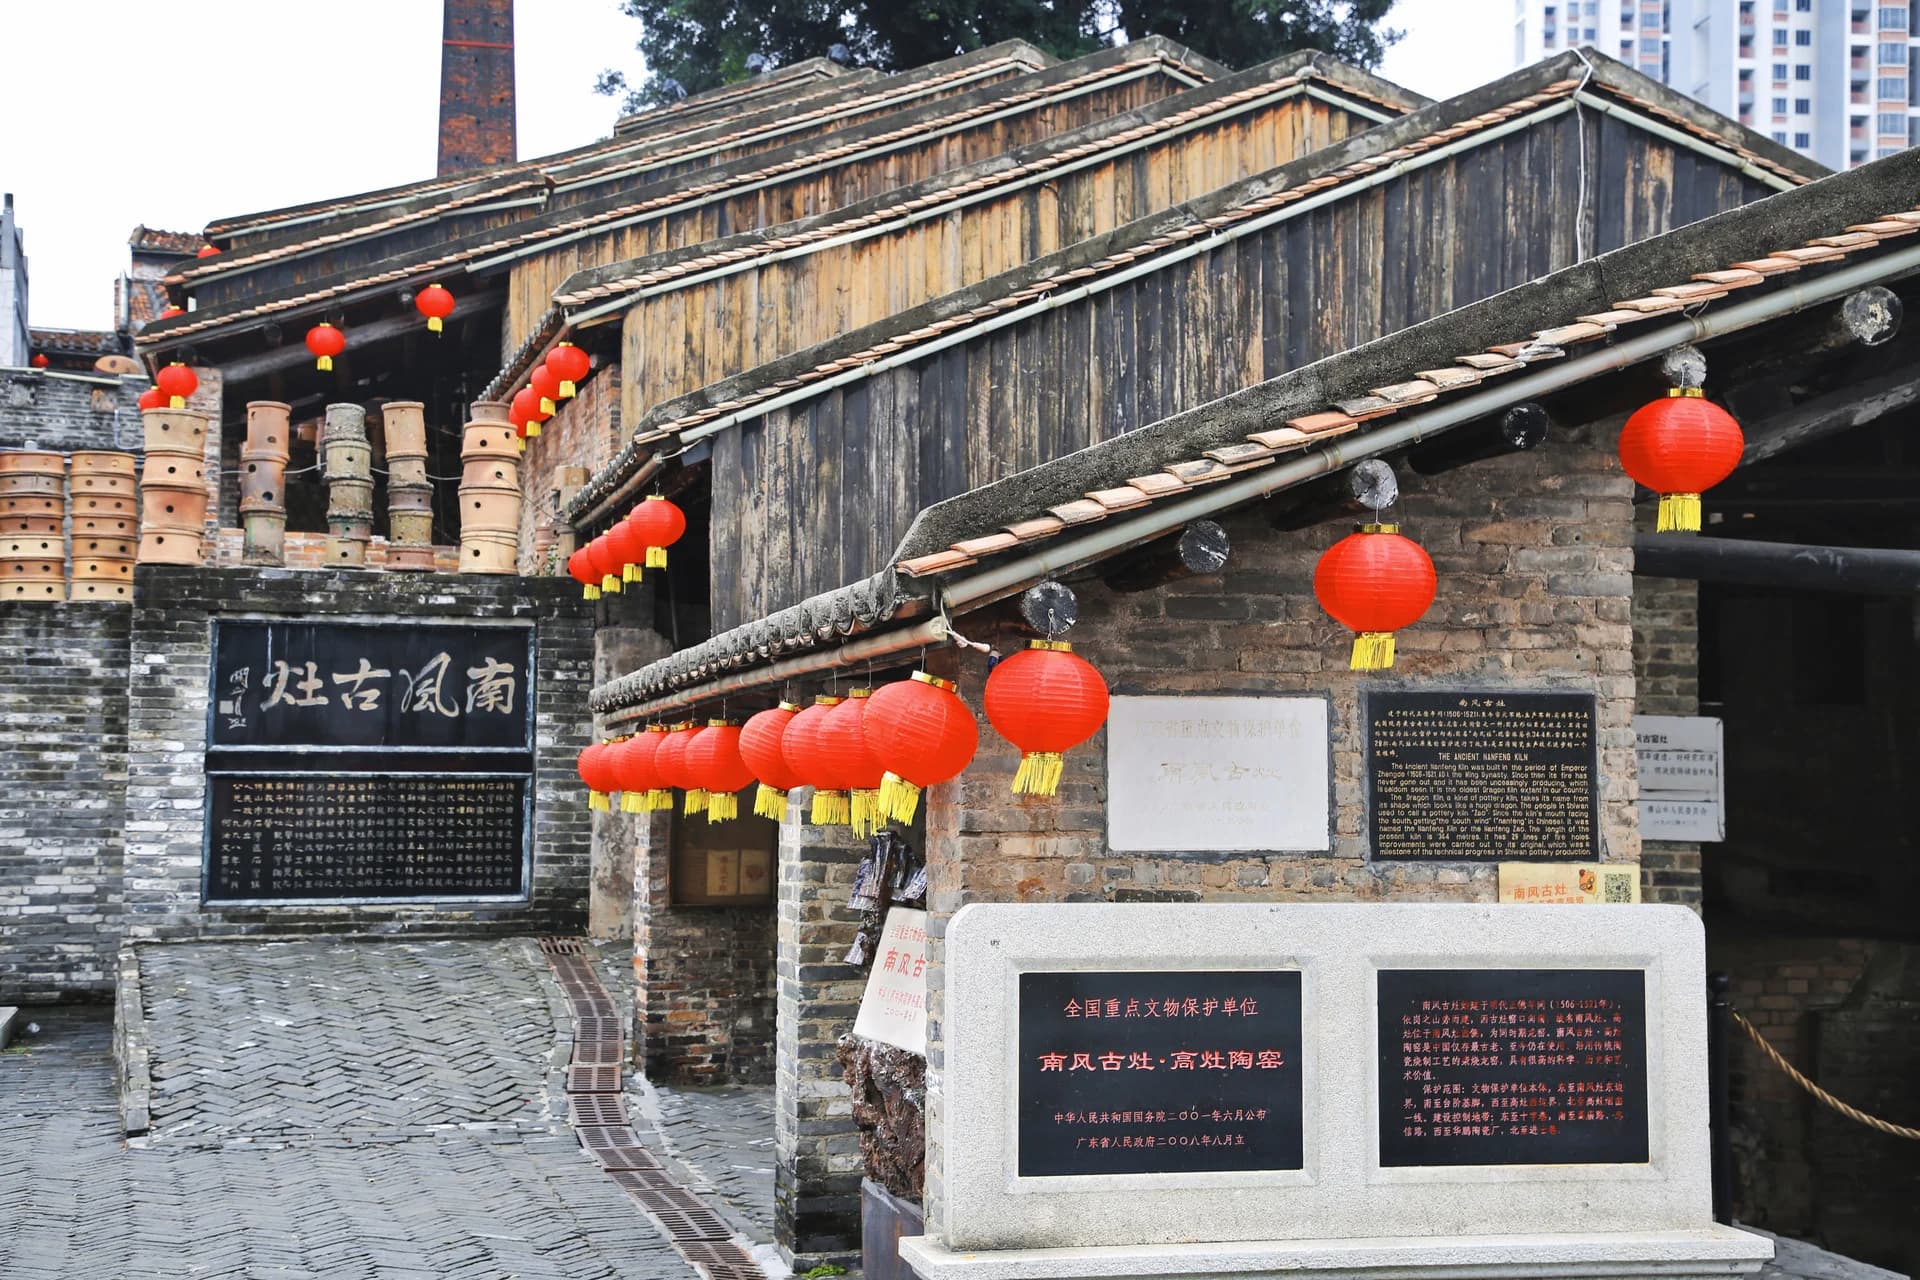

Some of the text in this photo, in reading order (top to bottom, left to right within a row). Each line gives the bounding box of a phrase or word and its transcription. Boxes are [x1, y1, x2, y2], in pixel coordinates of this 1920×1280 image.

[1438, 752, 1450, 760] THE
[1454, 753, 1479, 761] ANCIENT
[1514, 753, 1528, 761] KILN
[1430, 763, 1456, 772] Nanfeng
[1524, 764, 1546, 772] period
[1561, 764, 1587, 772] Emperor
[1378, 771, 1405, 779] Zhengde
[1490, 779, 1528, 788] unceasingly
[1482, 786, 1506, 795] Dragon
[1406, 794, 1429, 803] Dragon
[1479, 794, 1504, 803] pottery
[1520, 794, 1540, 802] takes
[1541, 794, 1550, 802] its
[1390, 802, 1410, 810] shape
[1475, 802, 1492, 810] huge
[1534, 802, 1557, 810] people
[1429, 809, 1454, 818] pottery
[1568, 810, 1588, 818] facing
[1417, 825, 1444, 834] Nanfeng
[1484, 825, 1510, 834] Nanfeng
[1545, 825, 1566, 834] length
[1379, 833, 1404, 842] present
[1379, 841, 1426, 849] Improvements
[1465, 849, 1495, 857] progress
[1505, 848, 1527, 856] Shiwan
[1529, 848, 1554, 857] pottery
[1513, 882, 1567, 900] 南风古灶
[1064, 997, 1258, 1018] 全国重点文物保护单位
